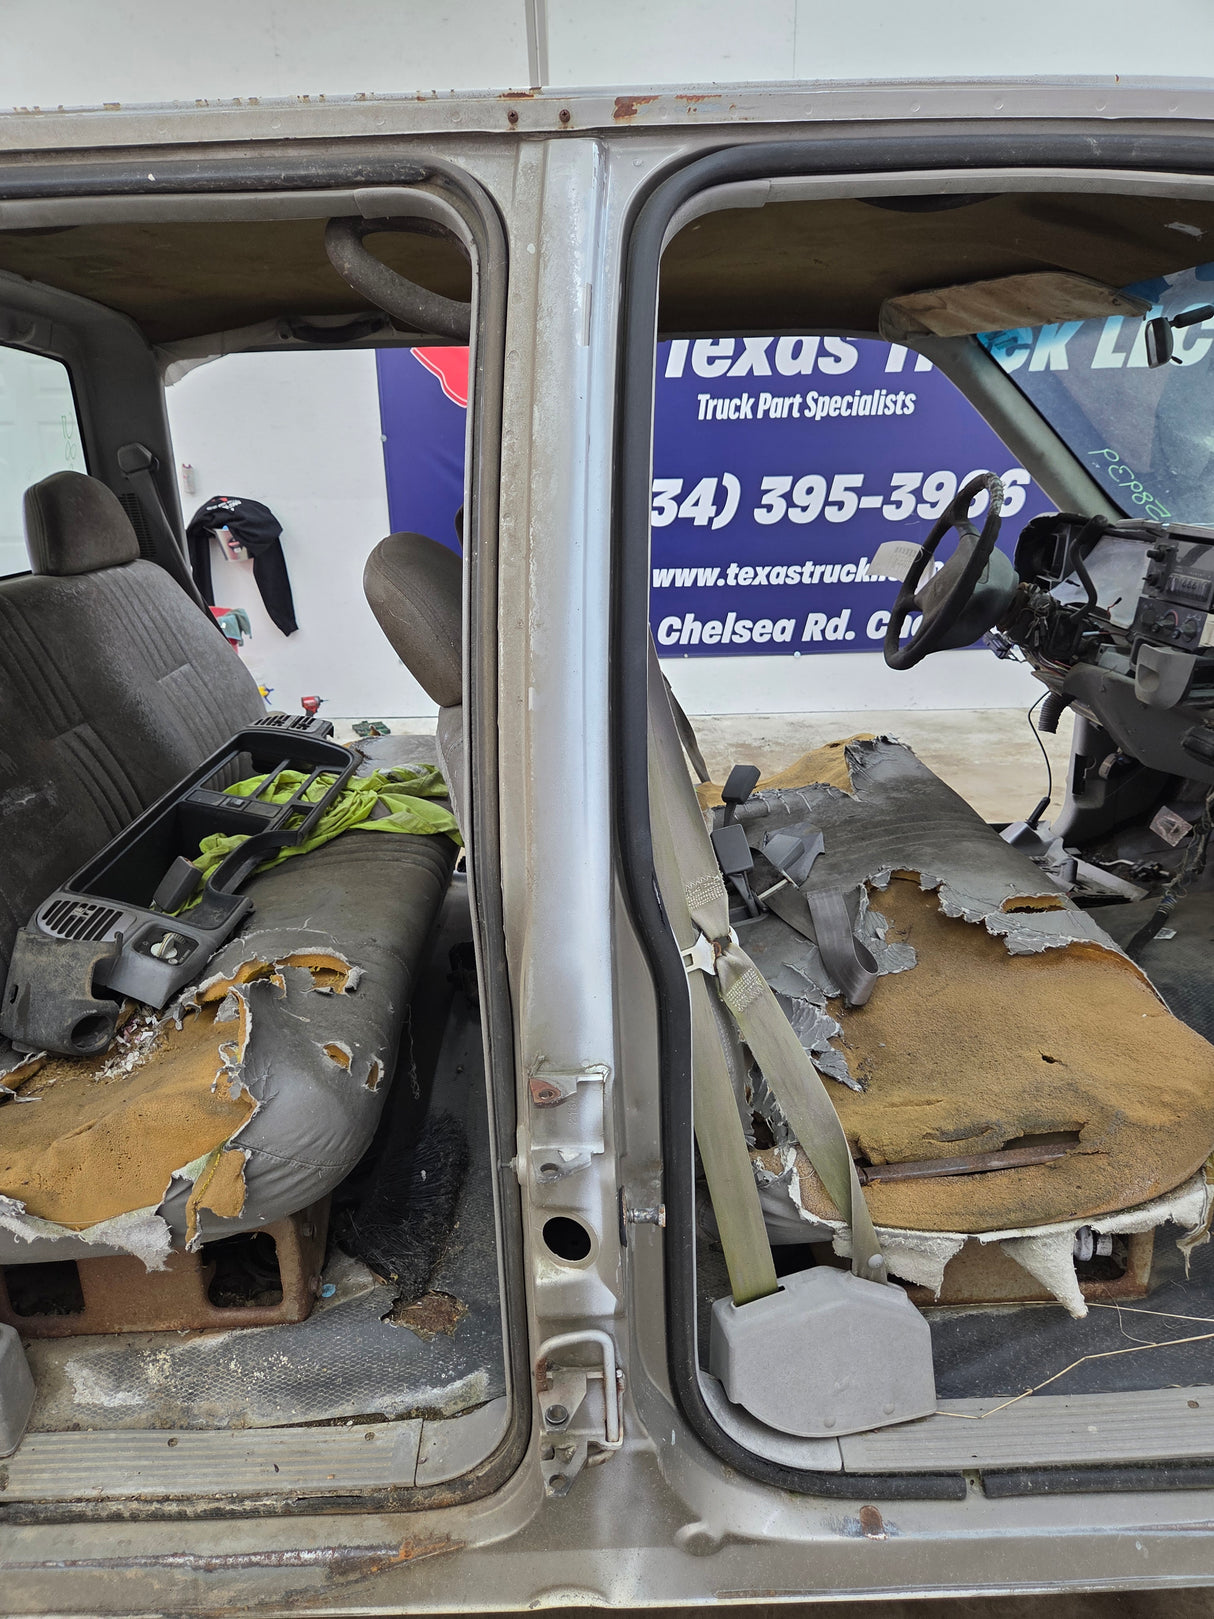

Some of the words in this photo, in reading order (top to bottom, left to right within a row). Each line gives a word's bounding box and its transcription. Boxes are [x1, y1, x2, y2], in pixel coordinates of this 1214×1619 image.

[697, 392, 755, 420] Truck
[757, 390, 802, 419] Part
[804, 389, 916, 421] Specialists
[652, 557, 944, 588] www.texastruck
[657, 612, 796, 645] Chelsea
[802, 609, 855, 641] Rd.
